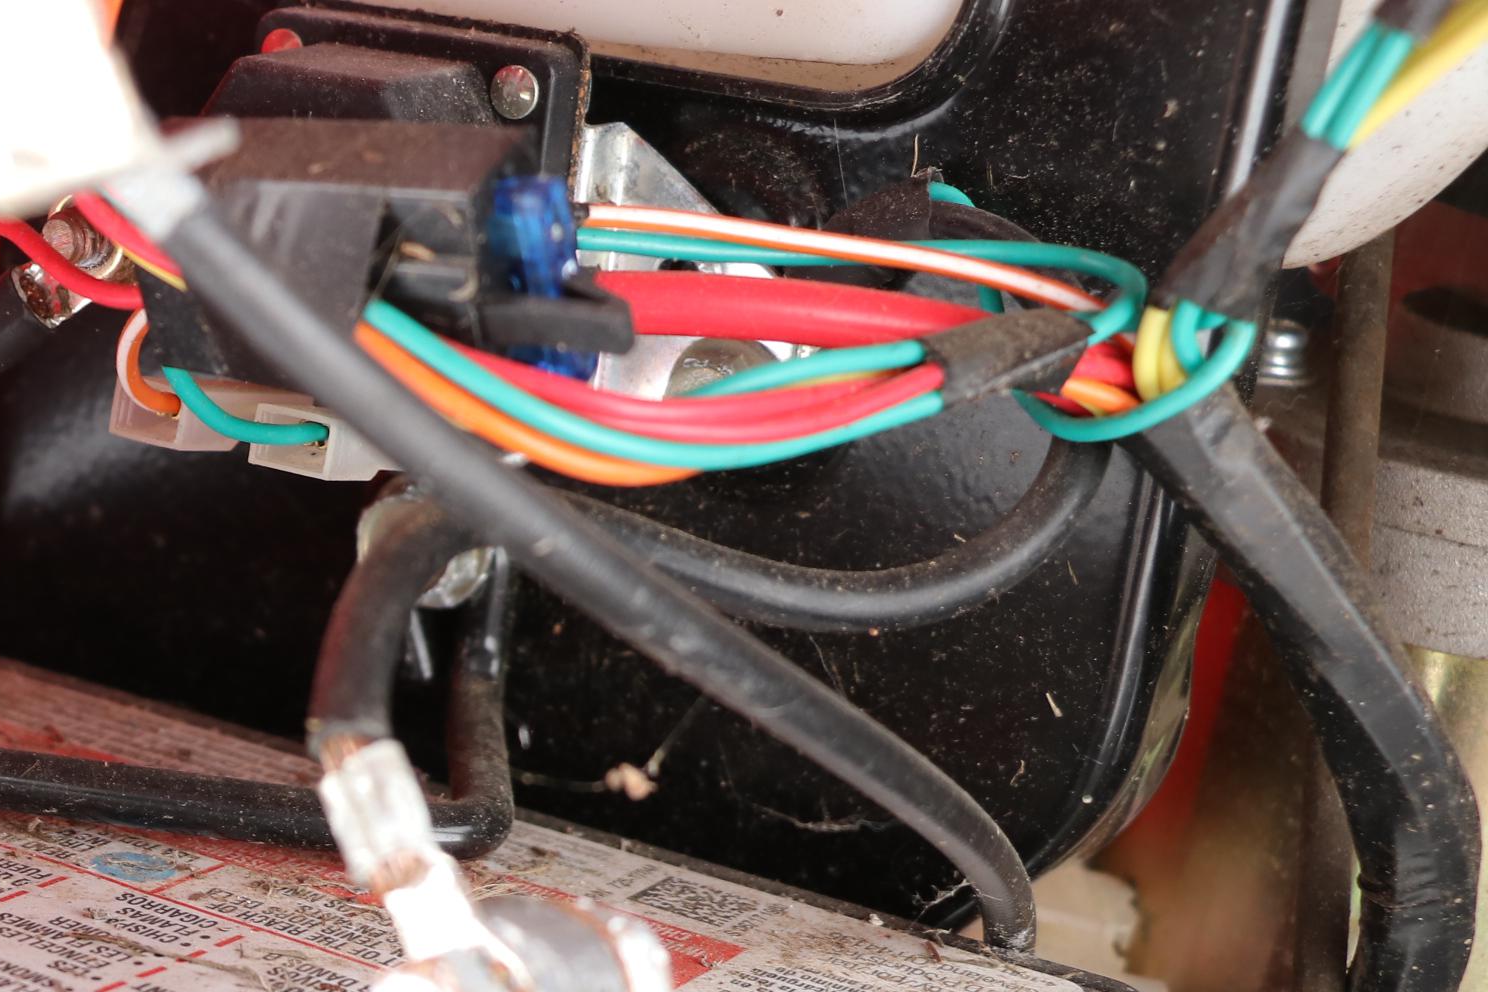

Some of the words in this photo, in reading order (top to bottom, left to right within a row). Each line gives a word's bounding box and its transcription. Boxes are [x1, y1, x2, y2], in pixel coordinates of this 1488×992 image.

[109, 891, 223, 929] CIGARROS
[202, 900, 242, 913] OF
[111, 906, 203, 936] FLAMAS
[232, 910, 310, 936] REACH
[299, 931, 352, 949] THE
[315, 924, 388, 949] TENIR
[85, 944, 136, 962] LES
[342, 945, 384, 960] OF
